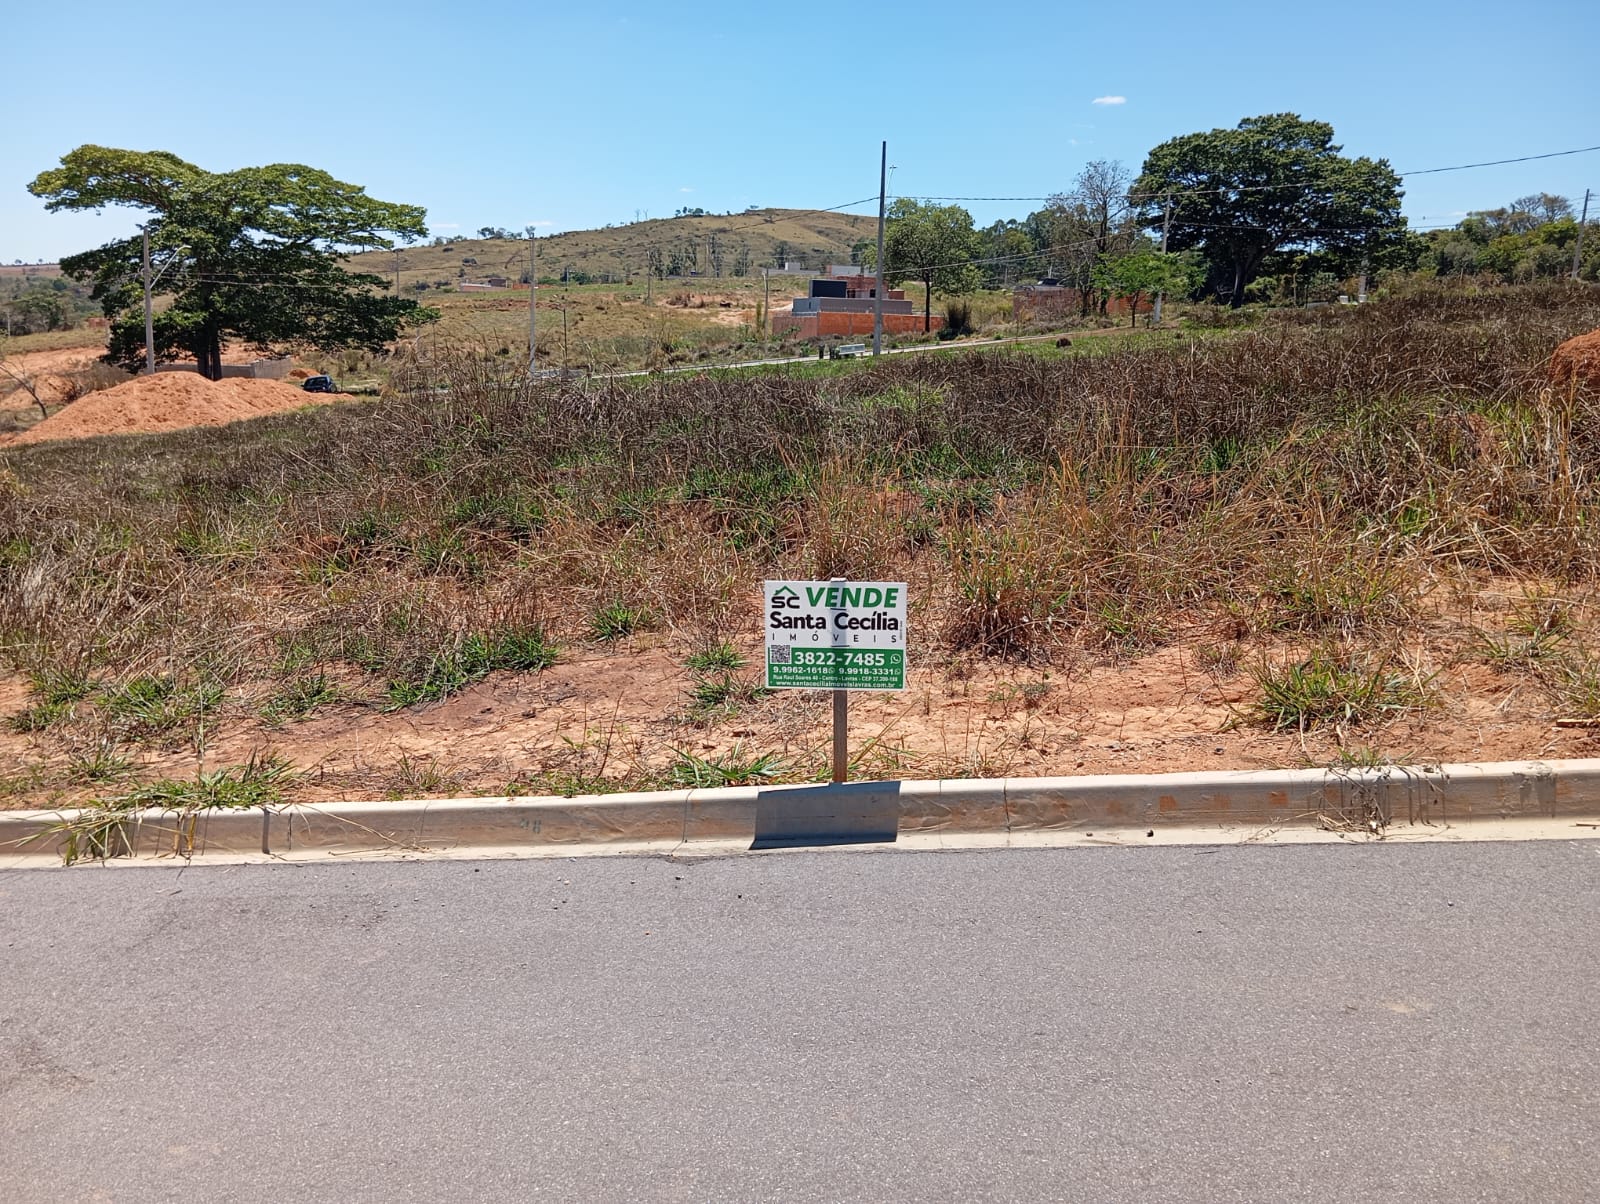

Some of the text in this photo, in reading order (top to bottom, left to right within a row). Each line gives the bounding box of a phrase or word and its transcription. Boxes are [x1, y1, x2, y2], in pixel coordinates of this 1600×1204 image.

[771, 596, 800, 609] SC
[805, 587, 899, 608] VENDE
[770, 611, 899, 630] Santa Cecília
[772, 631, 897, 643] IMÓVEIS
[794, 651, 885, 666] 3822-7485
[839, 667, 894, 676] 9.9918-3331
